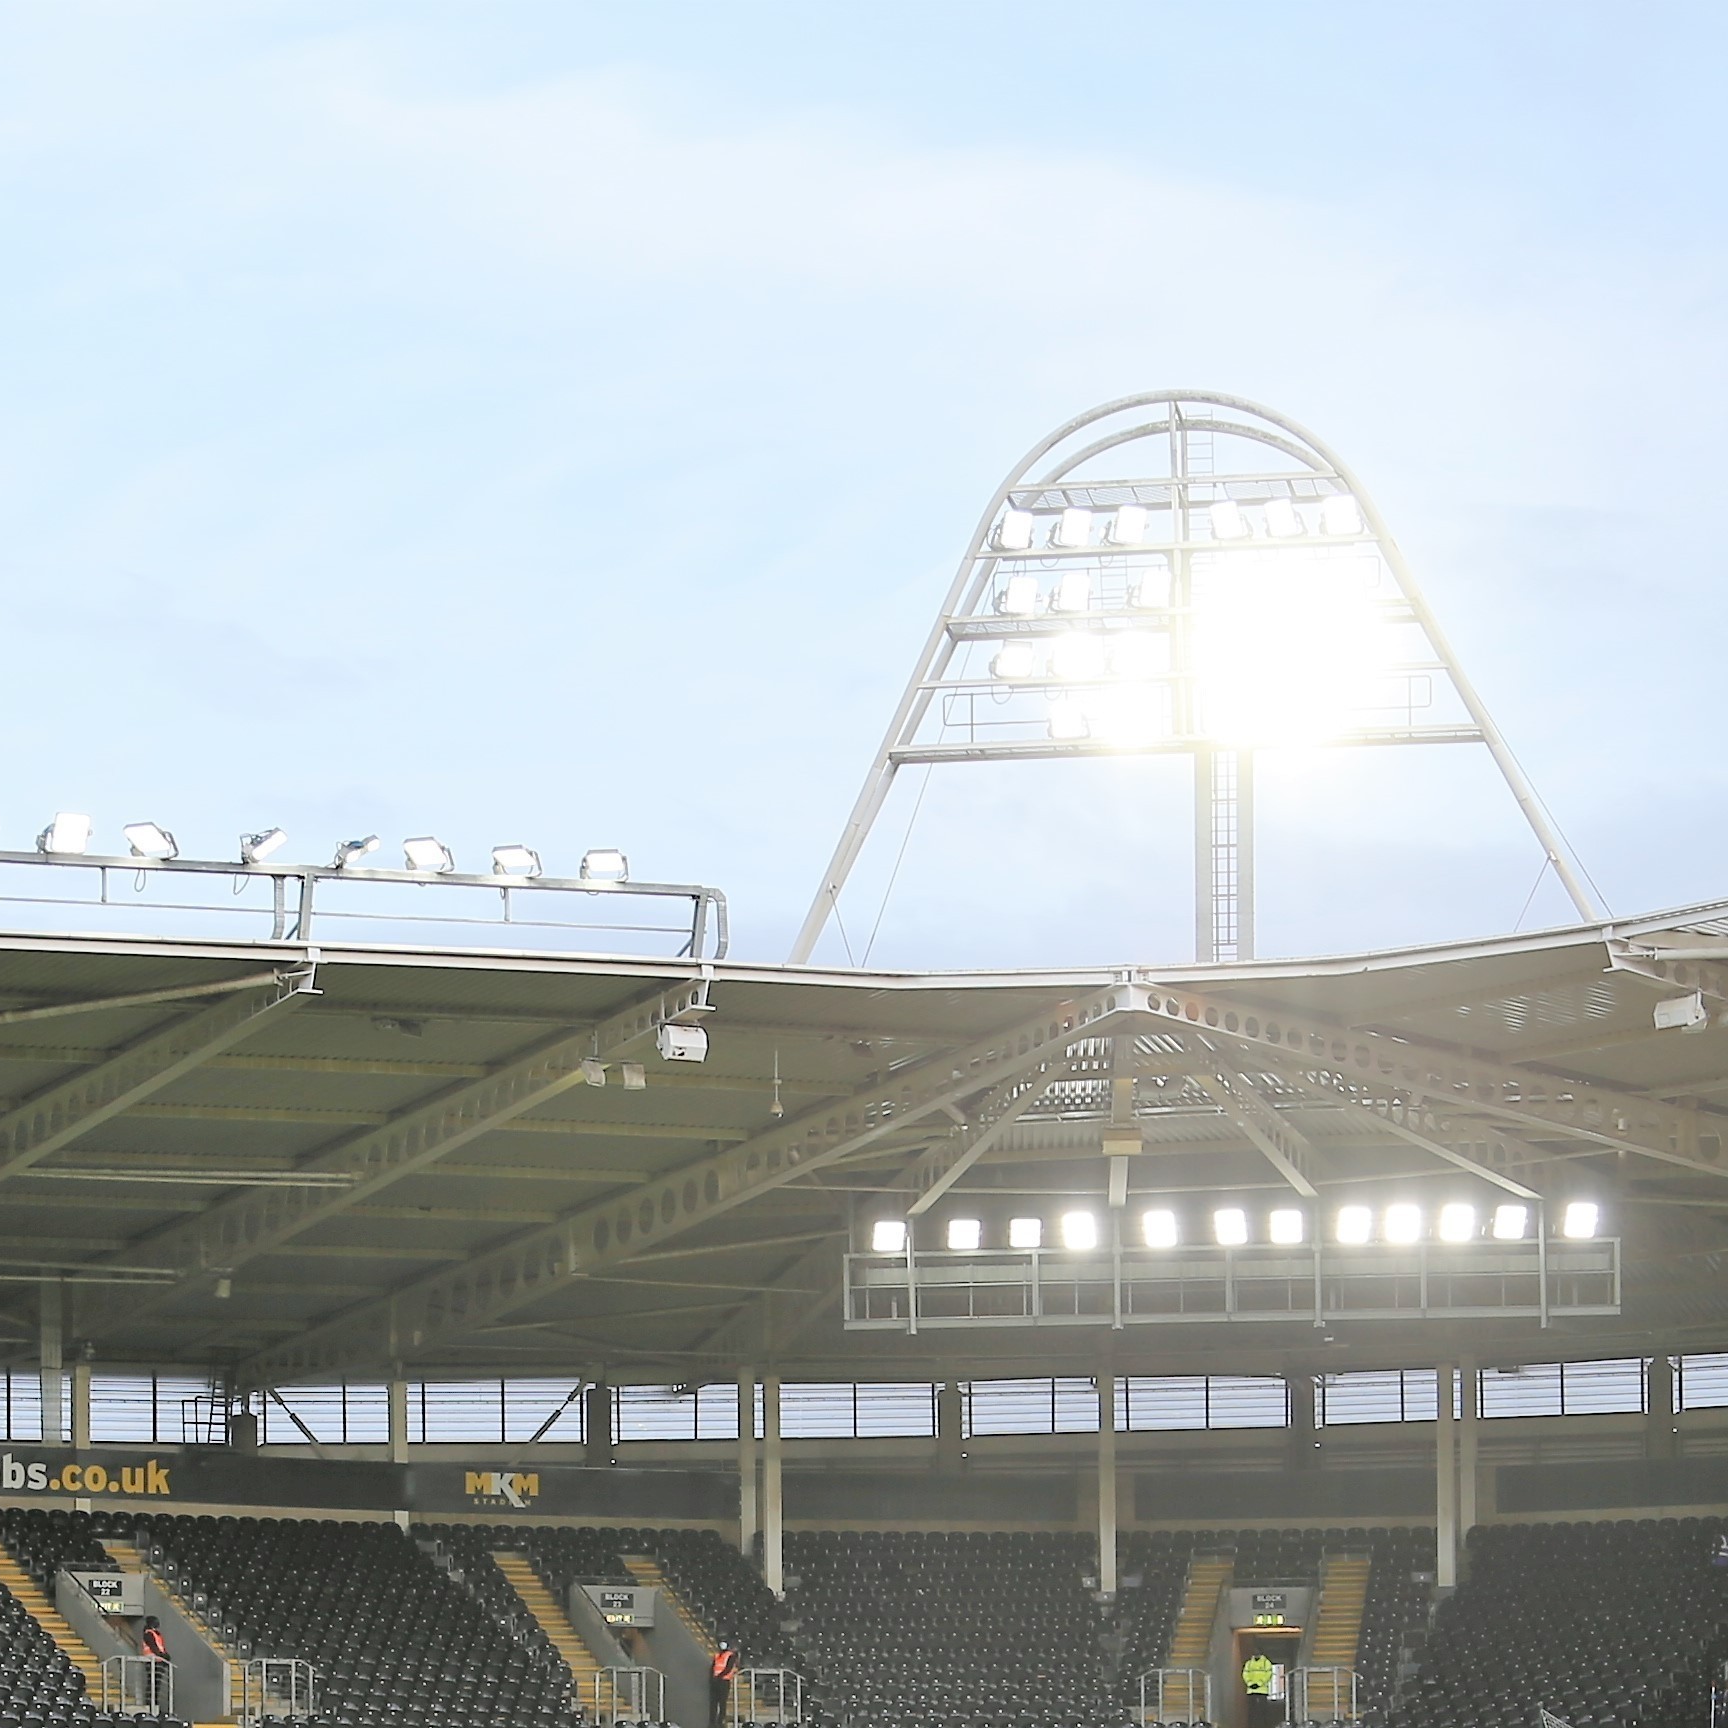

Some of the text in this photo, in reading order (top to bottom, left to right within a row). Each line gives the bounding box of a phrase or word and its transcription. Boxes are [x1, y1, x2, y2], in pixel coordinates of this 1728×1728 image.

[465, 1471, 539, 1508] MKM
[474, 1498, 531, 1506] STADM
[93, 1580, 118, 1588] BLOCK
[101, 1588, 110, 1596] 22
